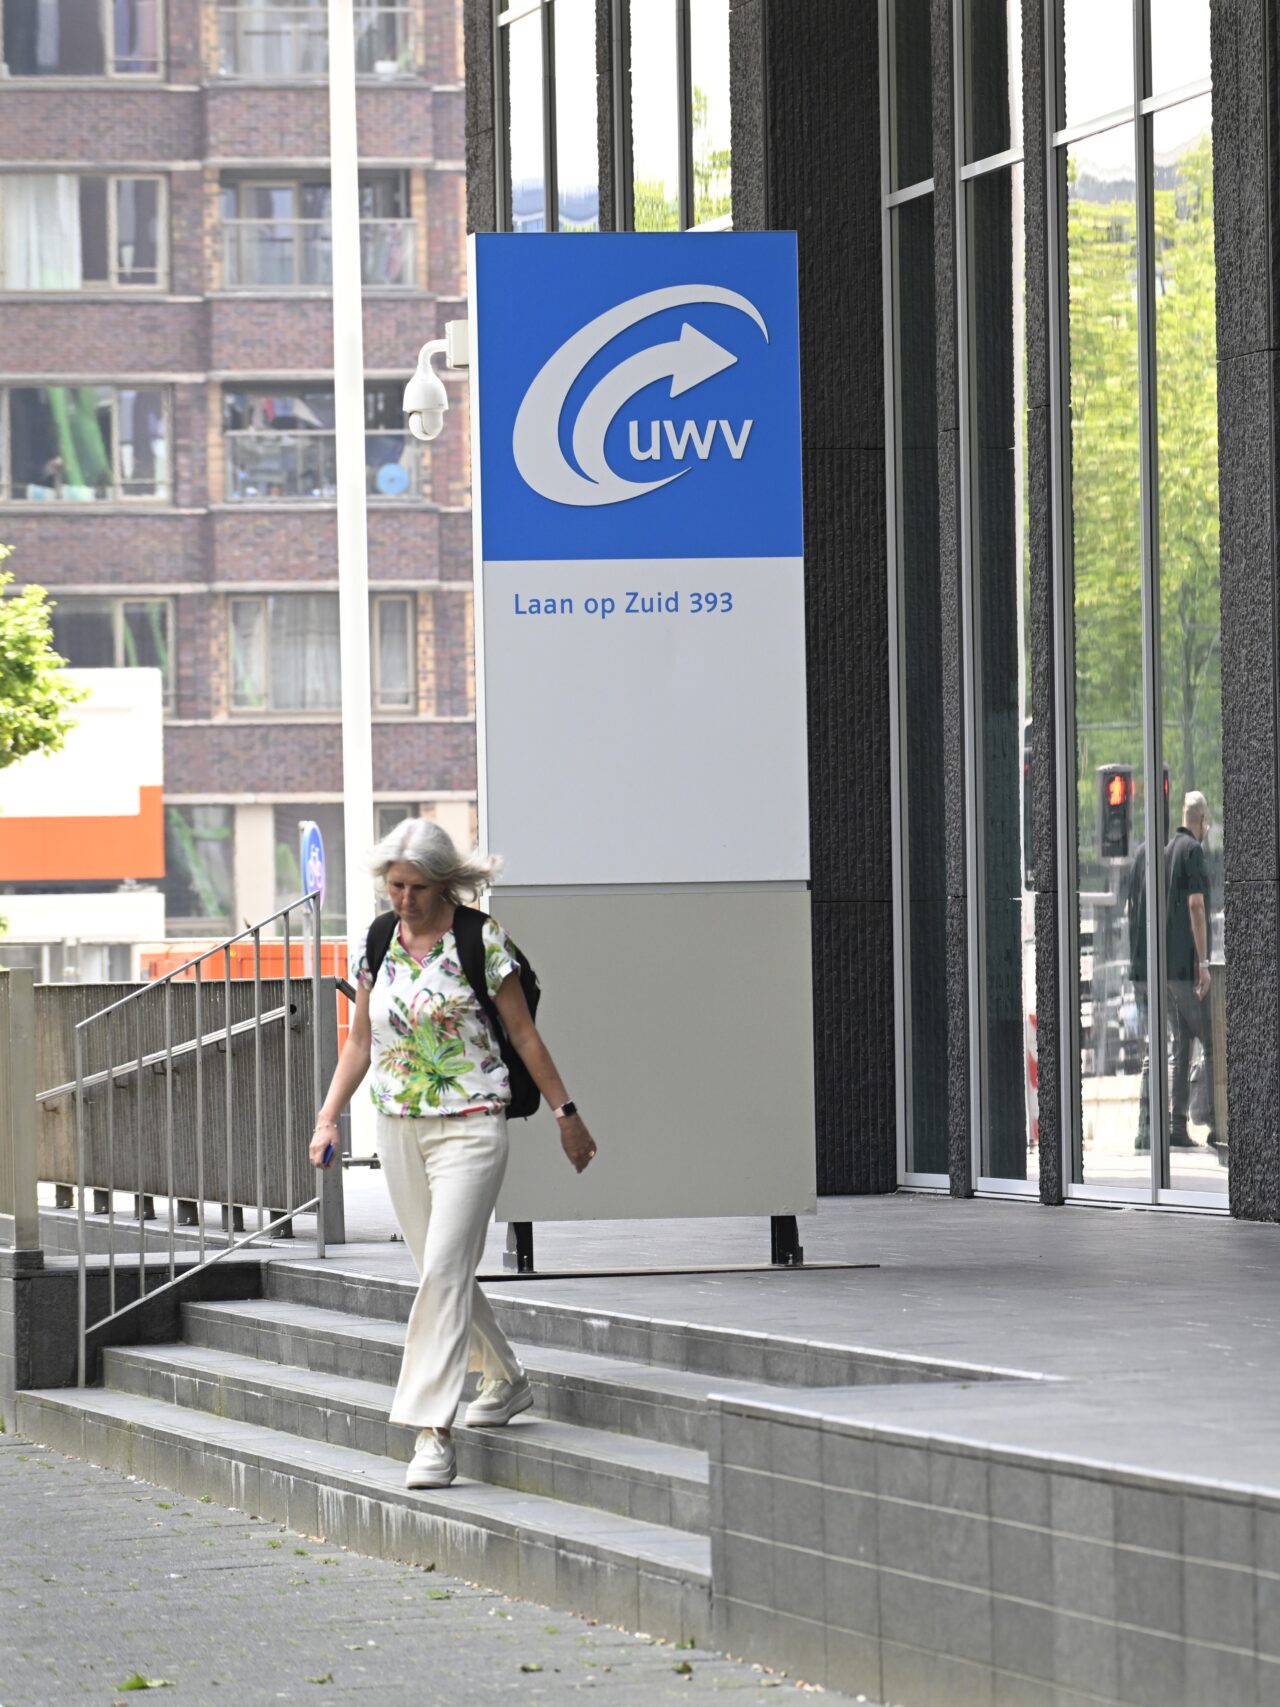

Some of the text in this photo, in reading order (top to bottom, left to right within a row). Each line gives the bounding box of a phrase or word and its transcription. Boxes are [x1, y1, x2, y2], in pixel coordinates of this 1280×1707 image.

[628, 419, 754, 460] uwv
[514, 591, 734, 620] Laan op Zuid 393
